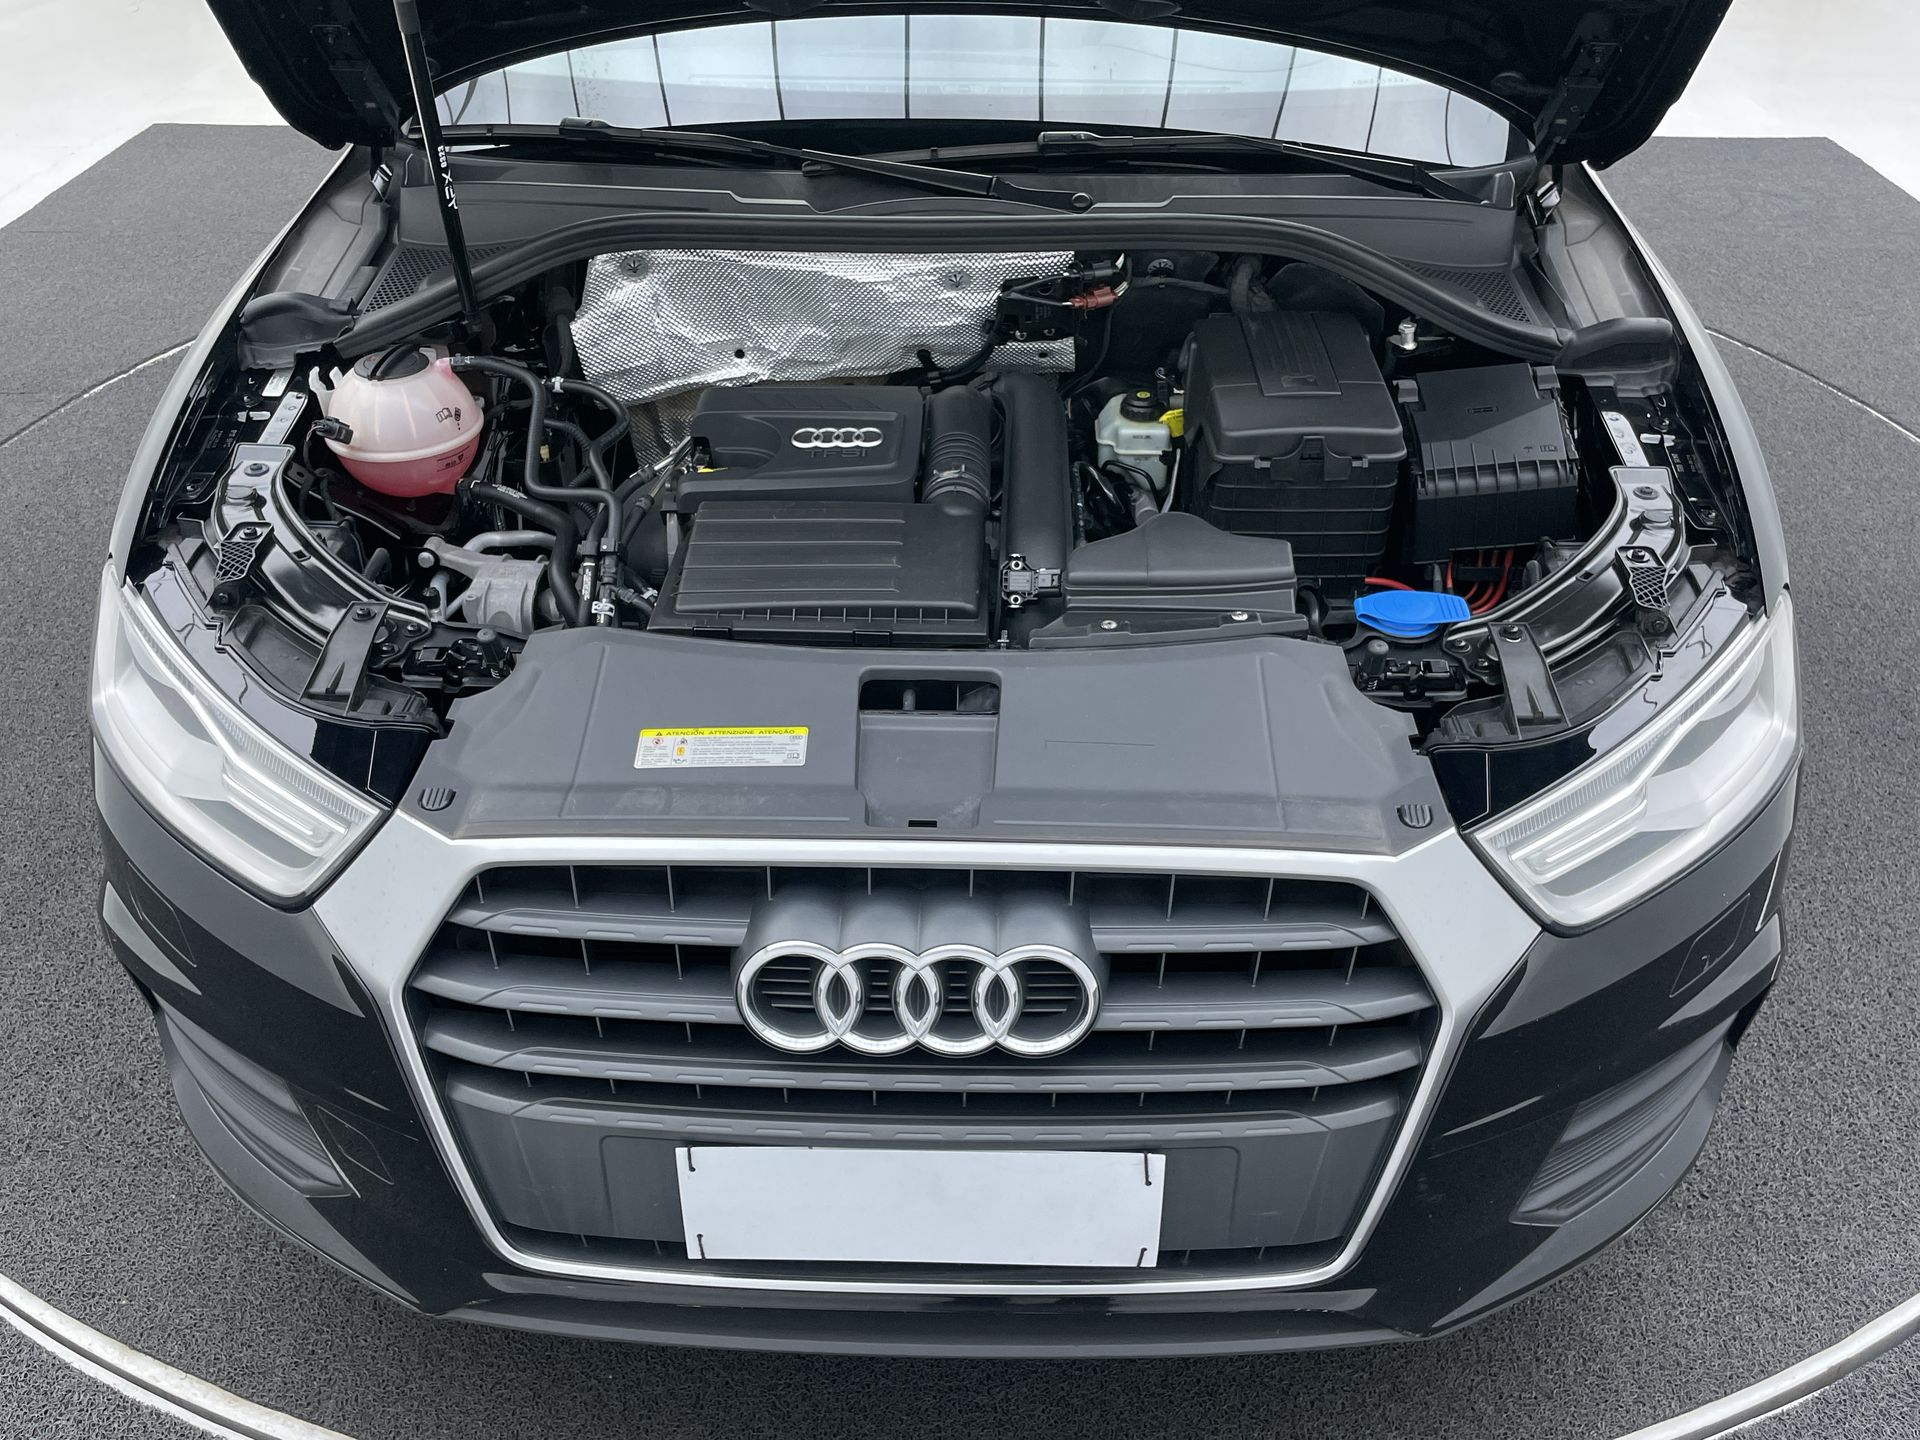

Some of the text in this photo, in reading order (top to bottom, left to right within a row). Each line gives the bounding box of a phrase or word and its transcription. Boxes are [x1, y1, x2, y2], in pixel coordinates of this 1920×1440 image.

[804, 449, 867, 458] TFSI
[666, 728, 705, 736] ATENCIÓN
[758, 728, 795, 736] ATENÇÃO
